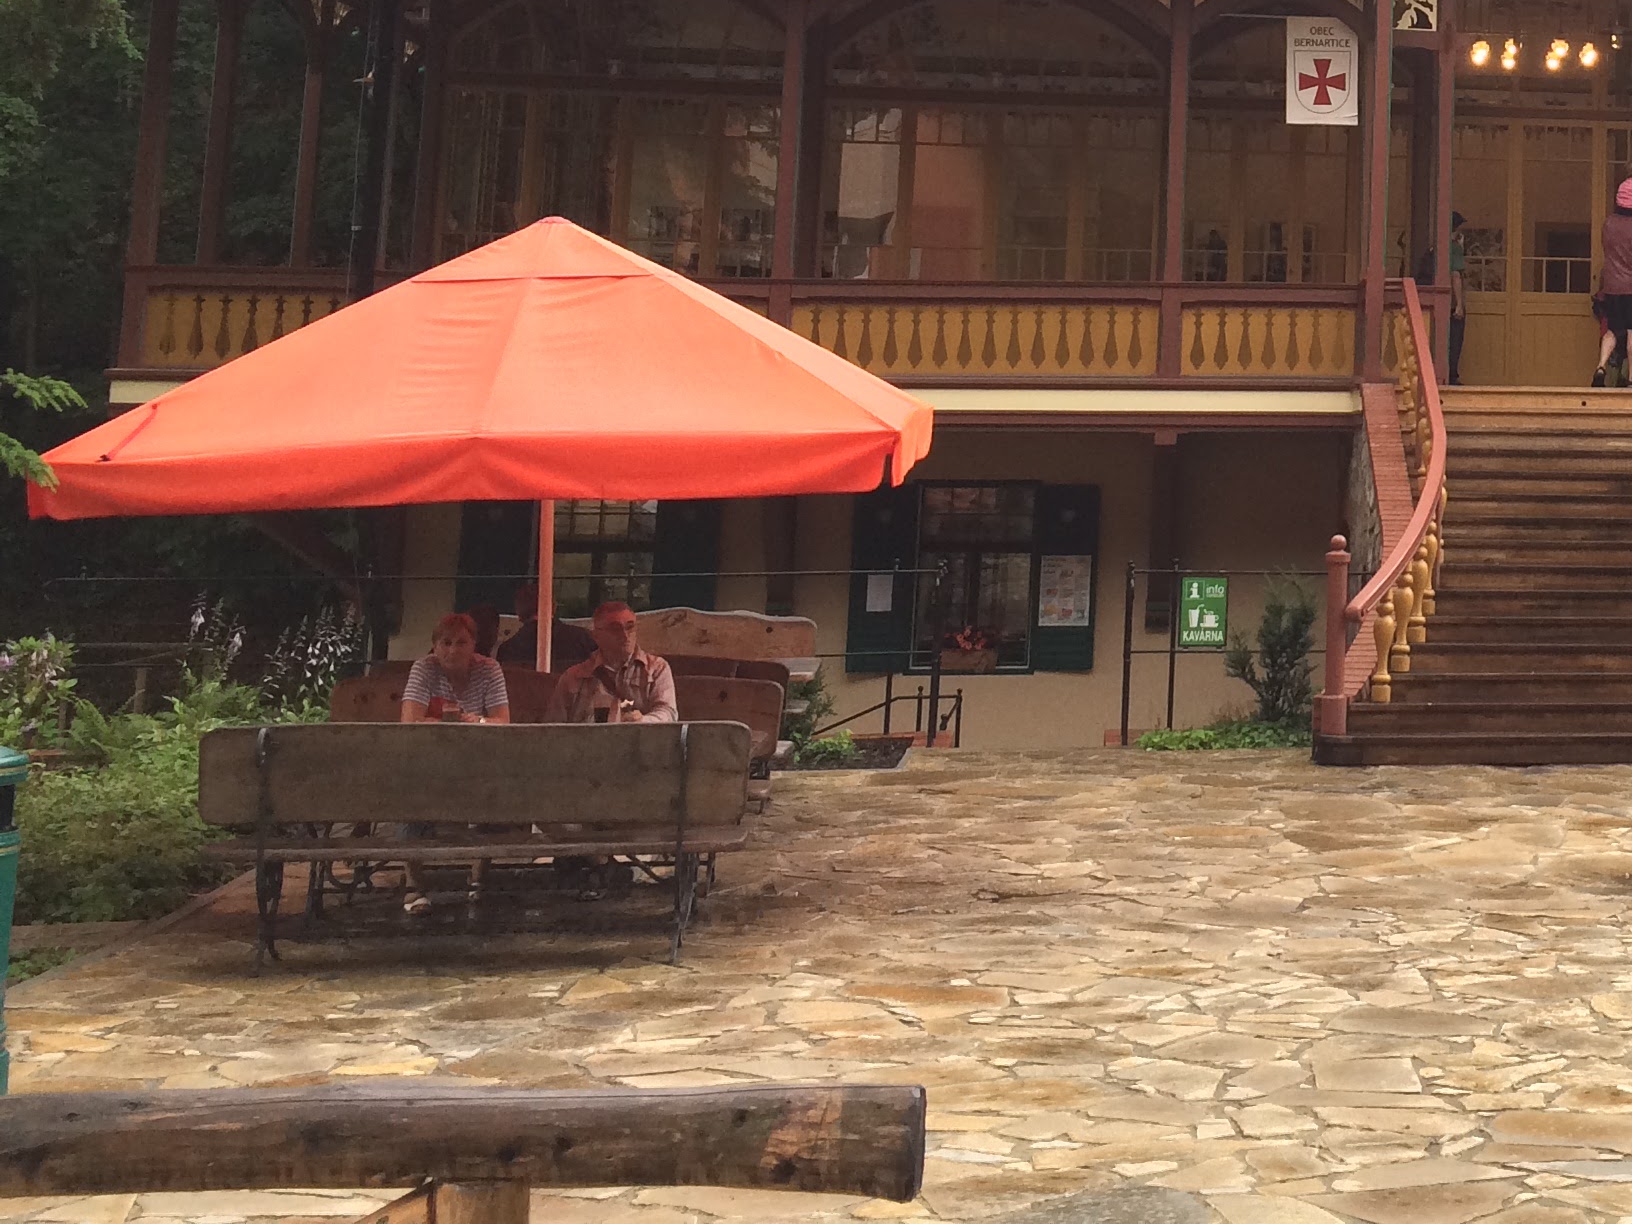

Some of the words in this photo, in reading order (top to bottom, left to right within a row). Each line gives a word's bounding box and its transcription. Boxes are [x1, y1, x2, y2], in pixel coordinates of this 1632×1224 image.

[1309, 26, 1335, 36] OBEC
[1294, 37, 1351, 48] BERNARTICE
[1182, 628, 1224, 642] KAVÁRNA
